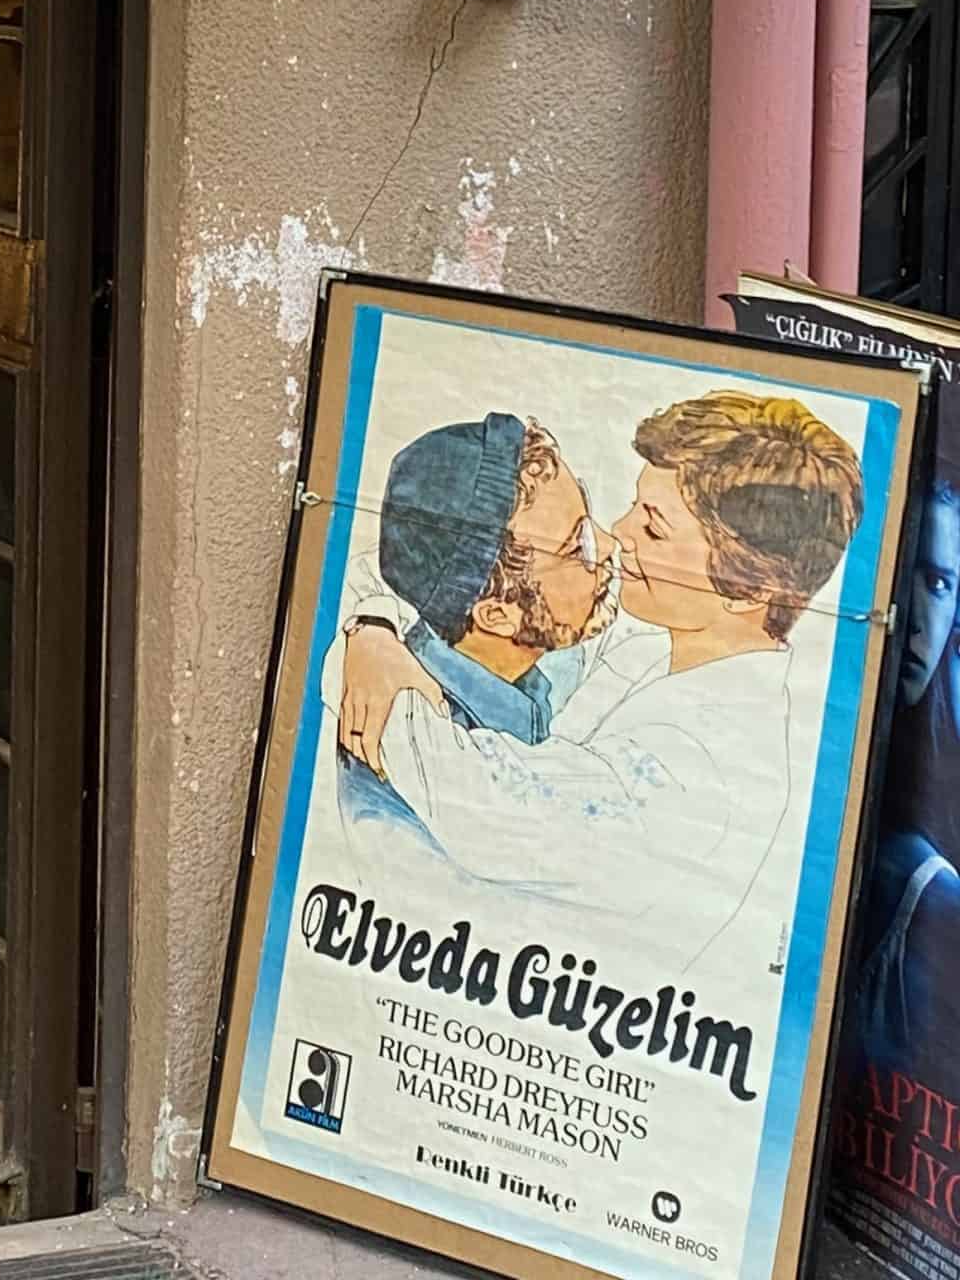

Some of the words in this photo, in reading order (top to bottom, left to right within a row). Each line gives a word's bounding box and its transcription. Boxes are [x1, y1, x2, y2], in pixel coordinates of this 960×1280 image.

[301, 884, 501, 1006] Elveda
[507, 944, 757, 1102] Güzelim
[443, 1019, 581, 1082] GOODBYE
[378, 1035, 498, 1091] RICHARD
[503, 1074, 649, 1140] DREYFUSS
[395, 1070, 512, 1127] MARSHA
[517, 1108, 622, 1162] MASON
[415, 1145, 490, 1184] Renkli
[497, 1170, 577, 1213] Türkçe
[491, 1135, 537, 1159] HERBERT
[539, 1151, 568, 1169] ROSS
[606, 1211, 671, 1246] WARNER
[675, 1235, 719, 1262] BROS
